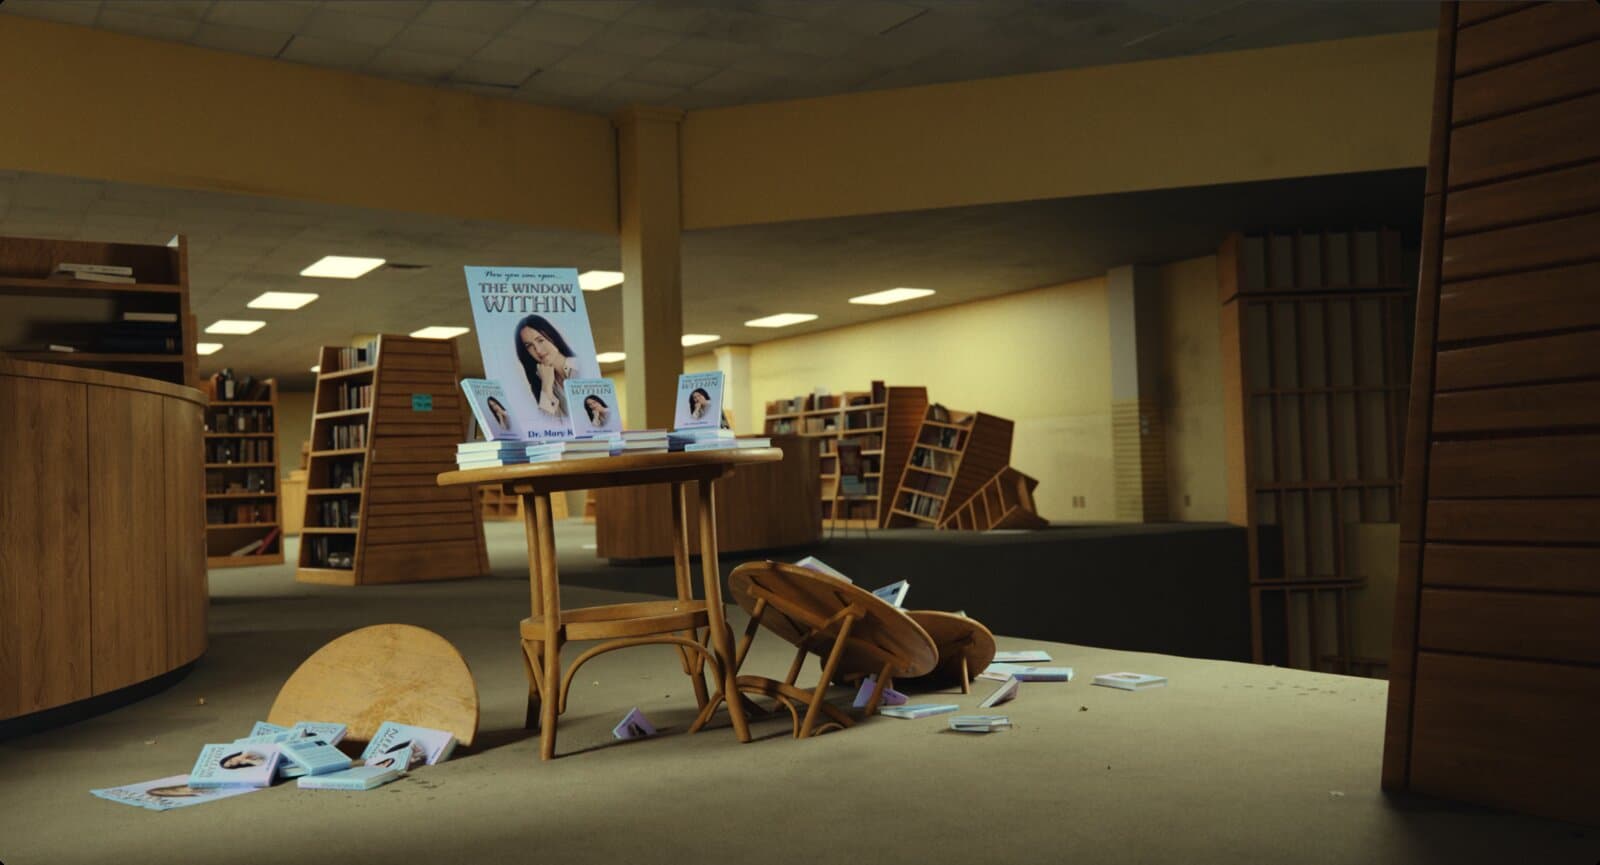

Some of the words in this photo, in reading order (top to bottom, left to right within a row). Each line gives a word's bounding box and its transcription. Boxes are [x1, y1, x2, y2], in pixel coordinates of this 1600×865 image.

[478, 282, 508, 294] THE
[511, 283, 573, 294] WINDOW
[482, 295, 577, 313] WITHIN
[527, 430, 542, 439] Dr.
[544, 429, 566, 439] Mary
